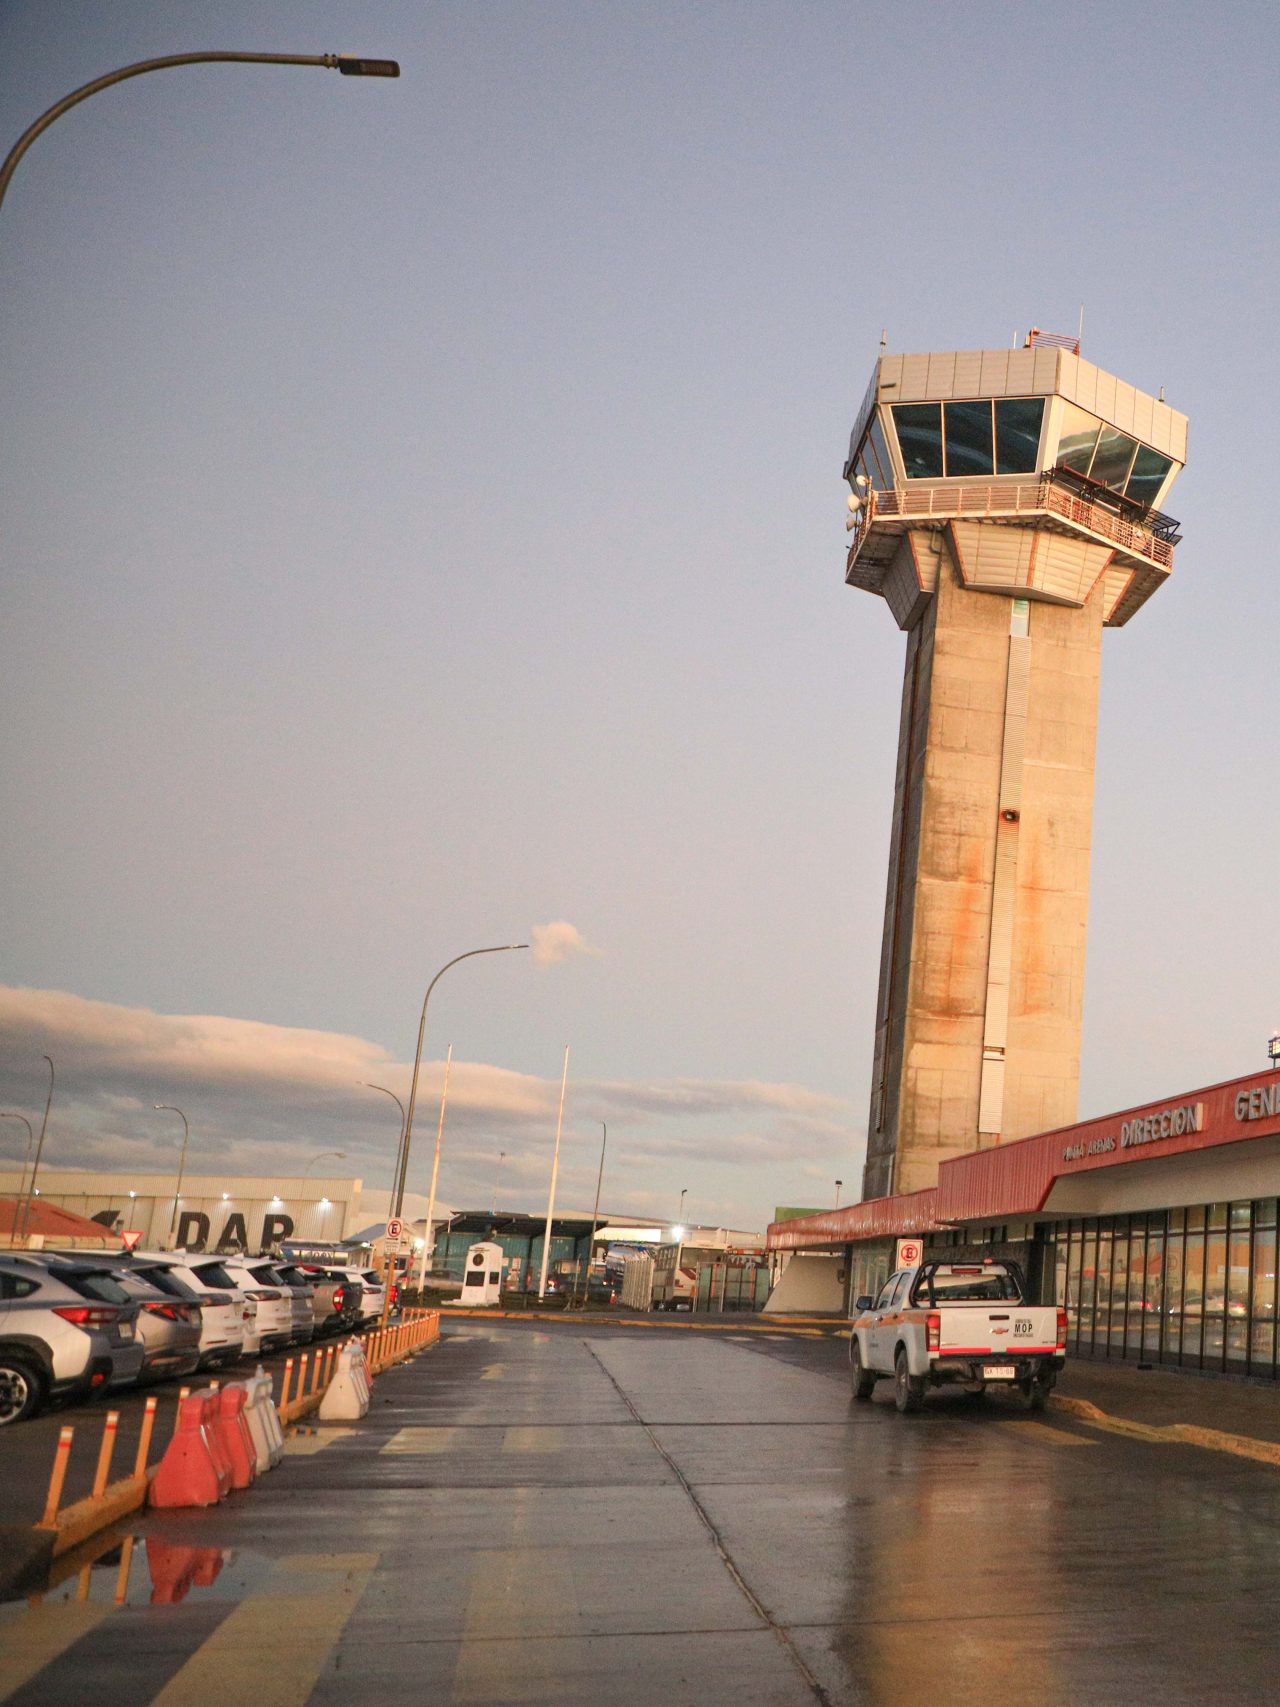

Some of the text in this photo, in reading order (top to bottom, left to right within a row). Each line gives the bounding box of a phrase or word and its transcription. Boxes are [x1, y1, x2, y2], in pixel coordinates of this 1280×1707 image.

[1063, 1143, 1083, 1161] PUNTA
[1088, 1137, 1116, 1156] ARENAS
[1120, 1102, 1204, 1148] DIRECCION
[175, 1211, 294, 1252] DAP
[1015, 1323, 1033, 1333] MOP
